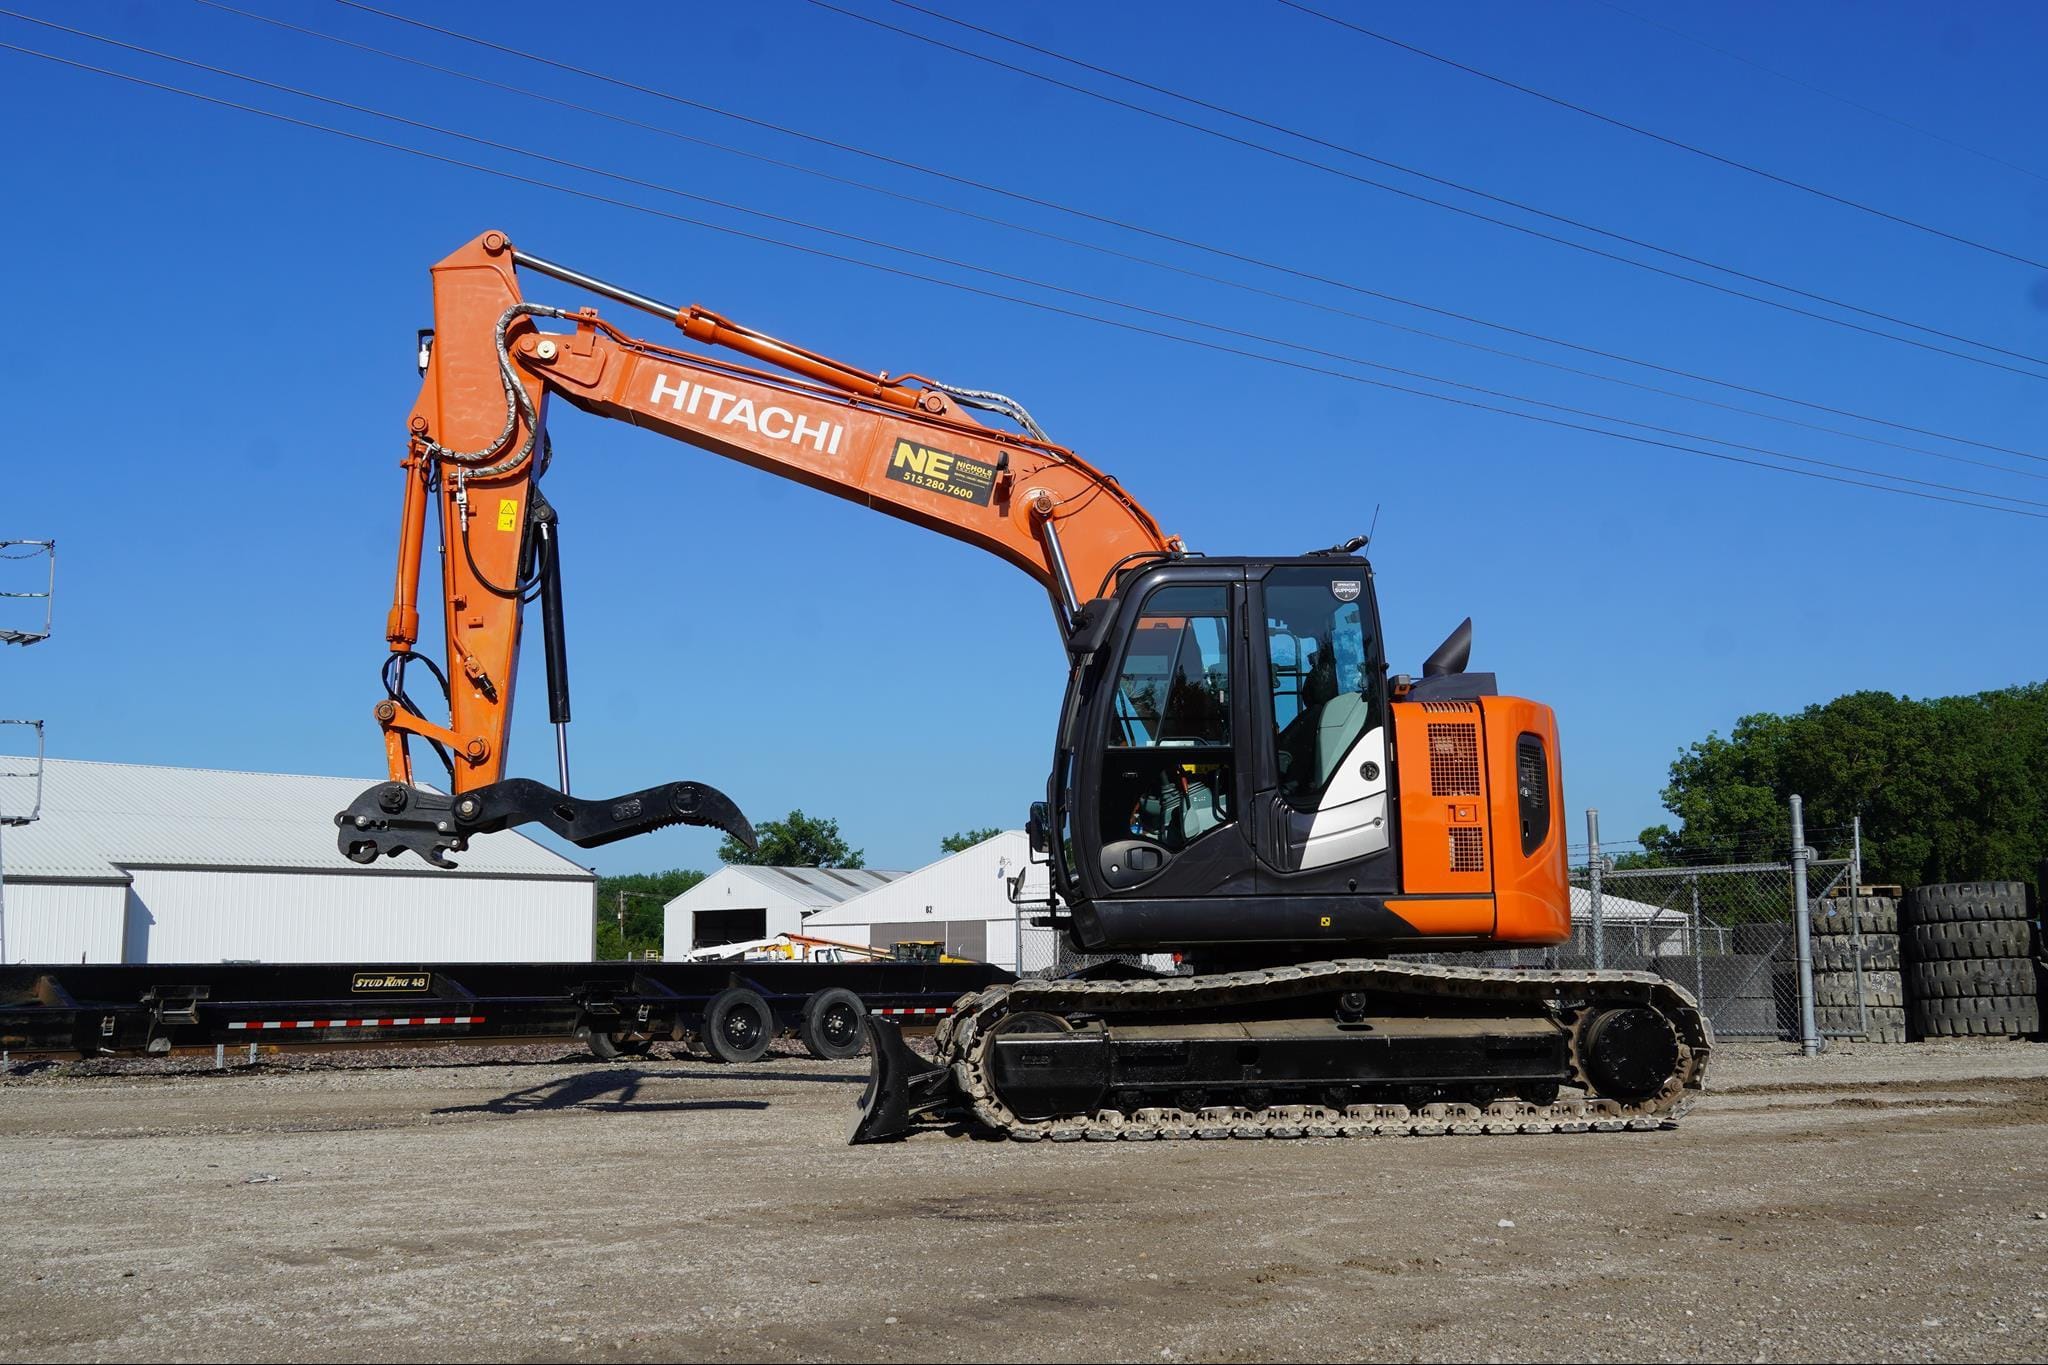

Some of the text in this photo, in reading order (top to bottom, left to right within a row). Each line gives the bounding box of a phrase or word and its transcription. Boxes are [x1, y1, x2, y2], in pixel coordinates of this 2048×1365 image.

[650, 373, 844, 455] HITACHI
[893, 442, 955, 481] NE
[955, 460, 993, 477] NICHOLS
[903, 471, 974, 499] 515.280.7600
[355, 978, 383, 987] STUD
[411, 978, 425, 987] 48
